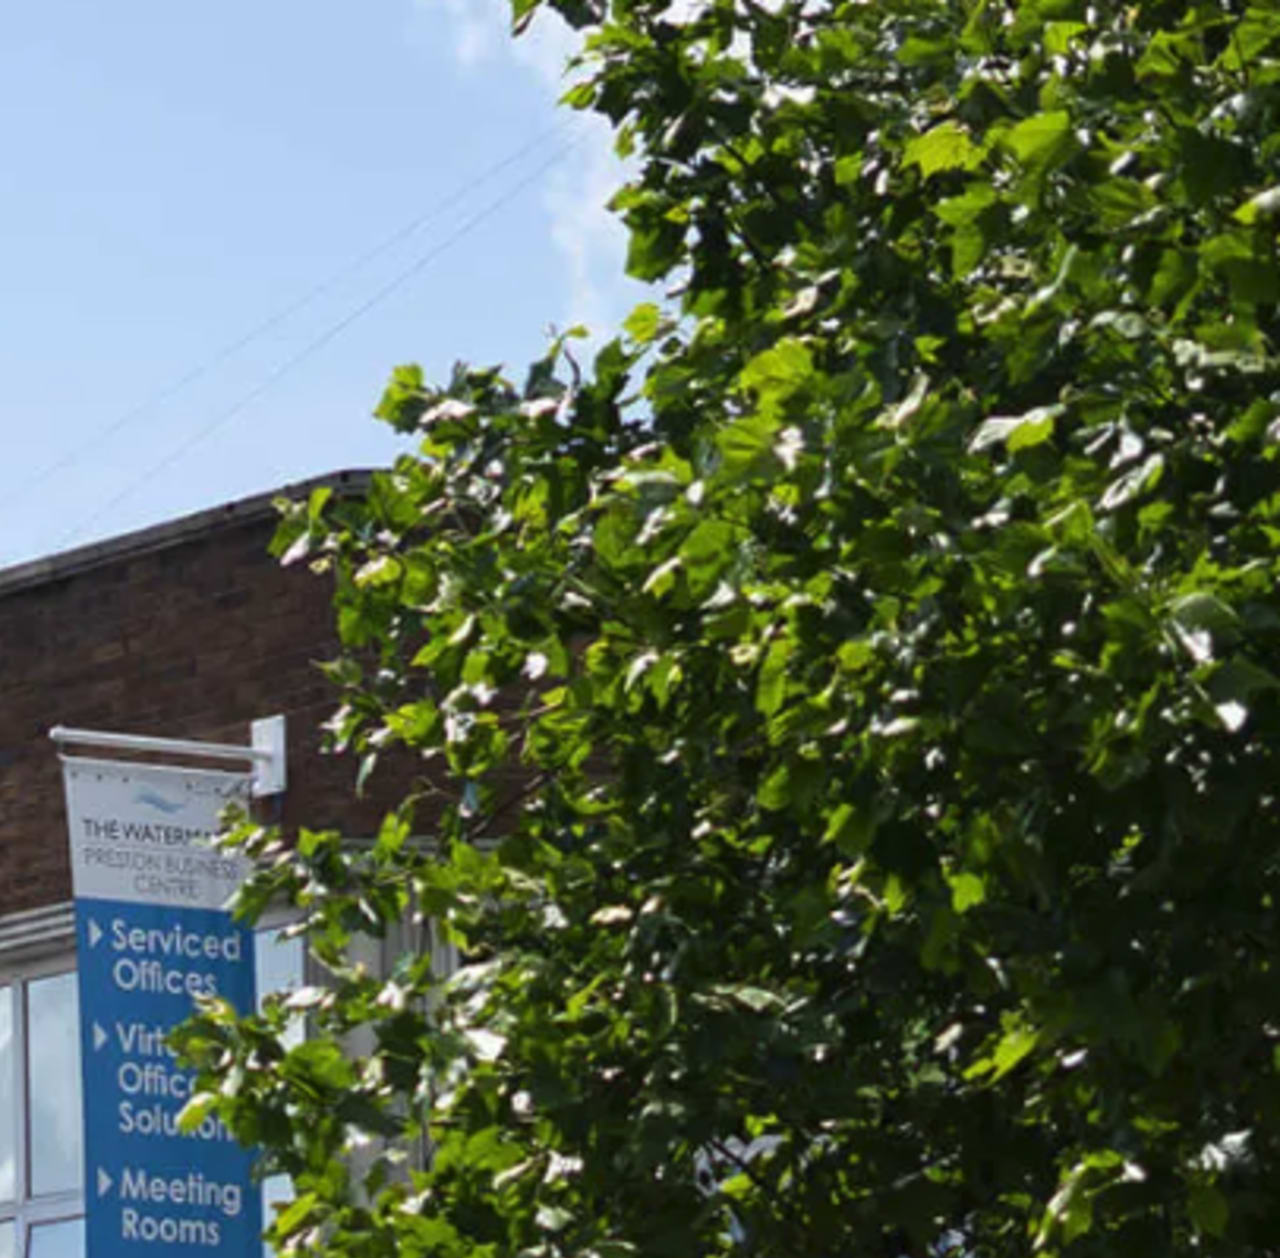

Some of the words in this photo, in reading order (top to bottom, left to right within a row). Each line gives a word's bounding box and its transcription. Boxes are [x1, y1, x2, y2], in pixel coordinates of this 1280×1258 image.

[82, 818, 119, 839] THE
[123, 822, 213, 845] WATERM
[82, 846, 161, 870] PRESTON
[165, 853, 239, 880] BUSINESS
[133, 872, 201, 900] CENTRE
[111, 917, 241, 962] Serviced
[113, 959, 217, 996] Offices
[116, 1021, 179, 1058] Virt
[118, 1061, 197, 1098] Offic
[120, 1168, 242, 1216] Meeting
[121, 1209, 221, 1246] Rooms
